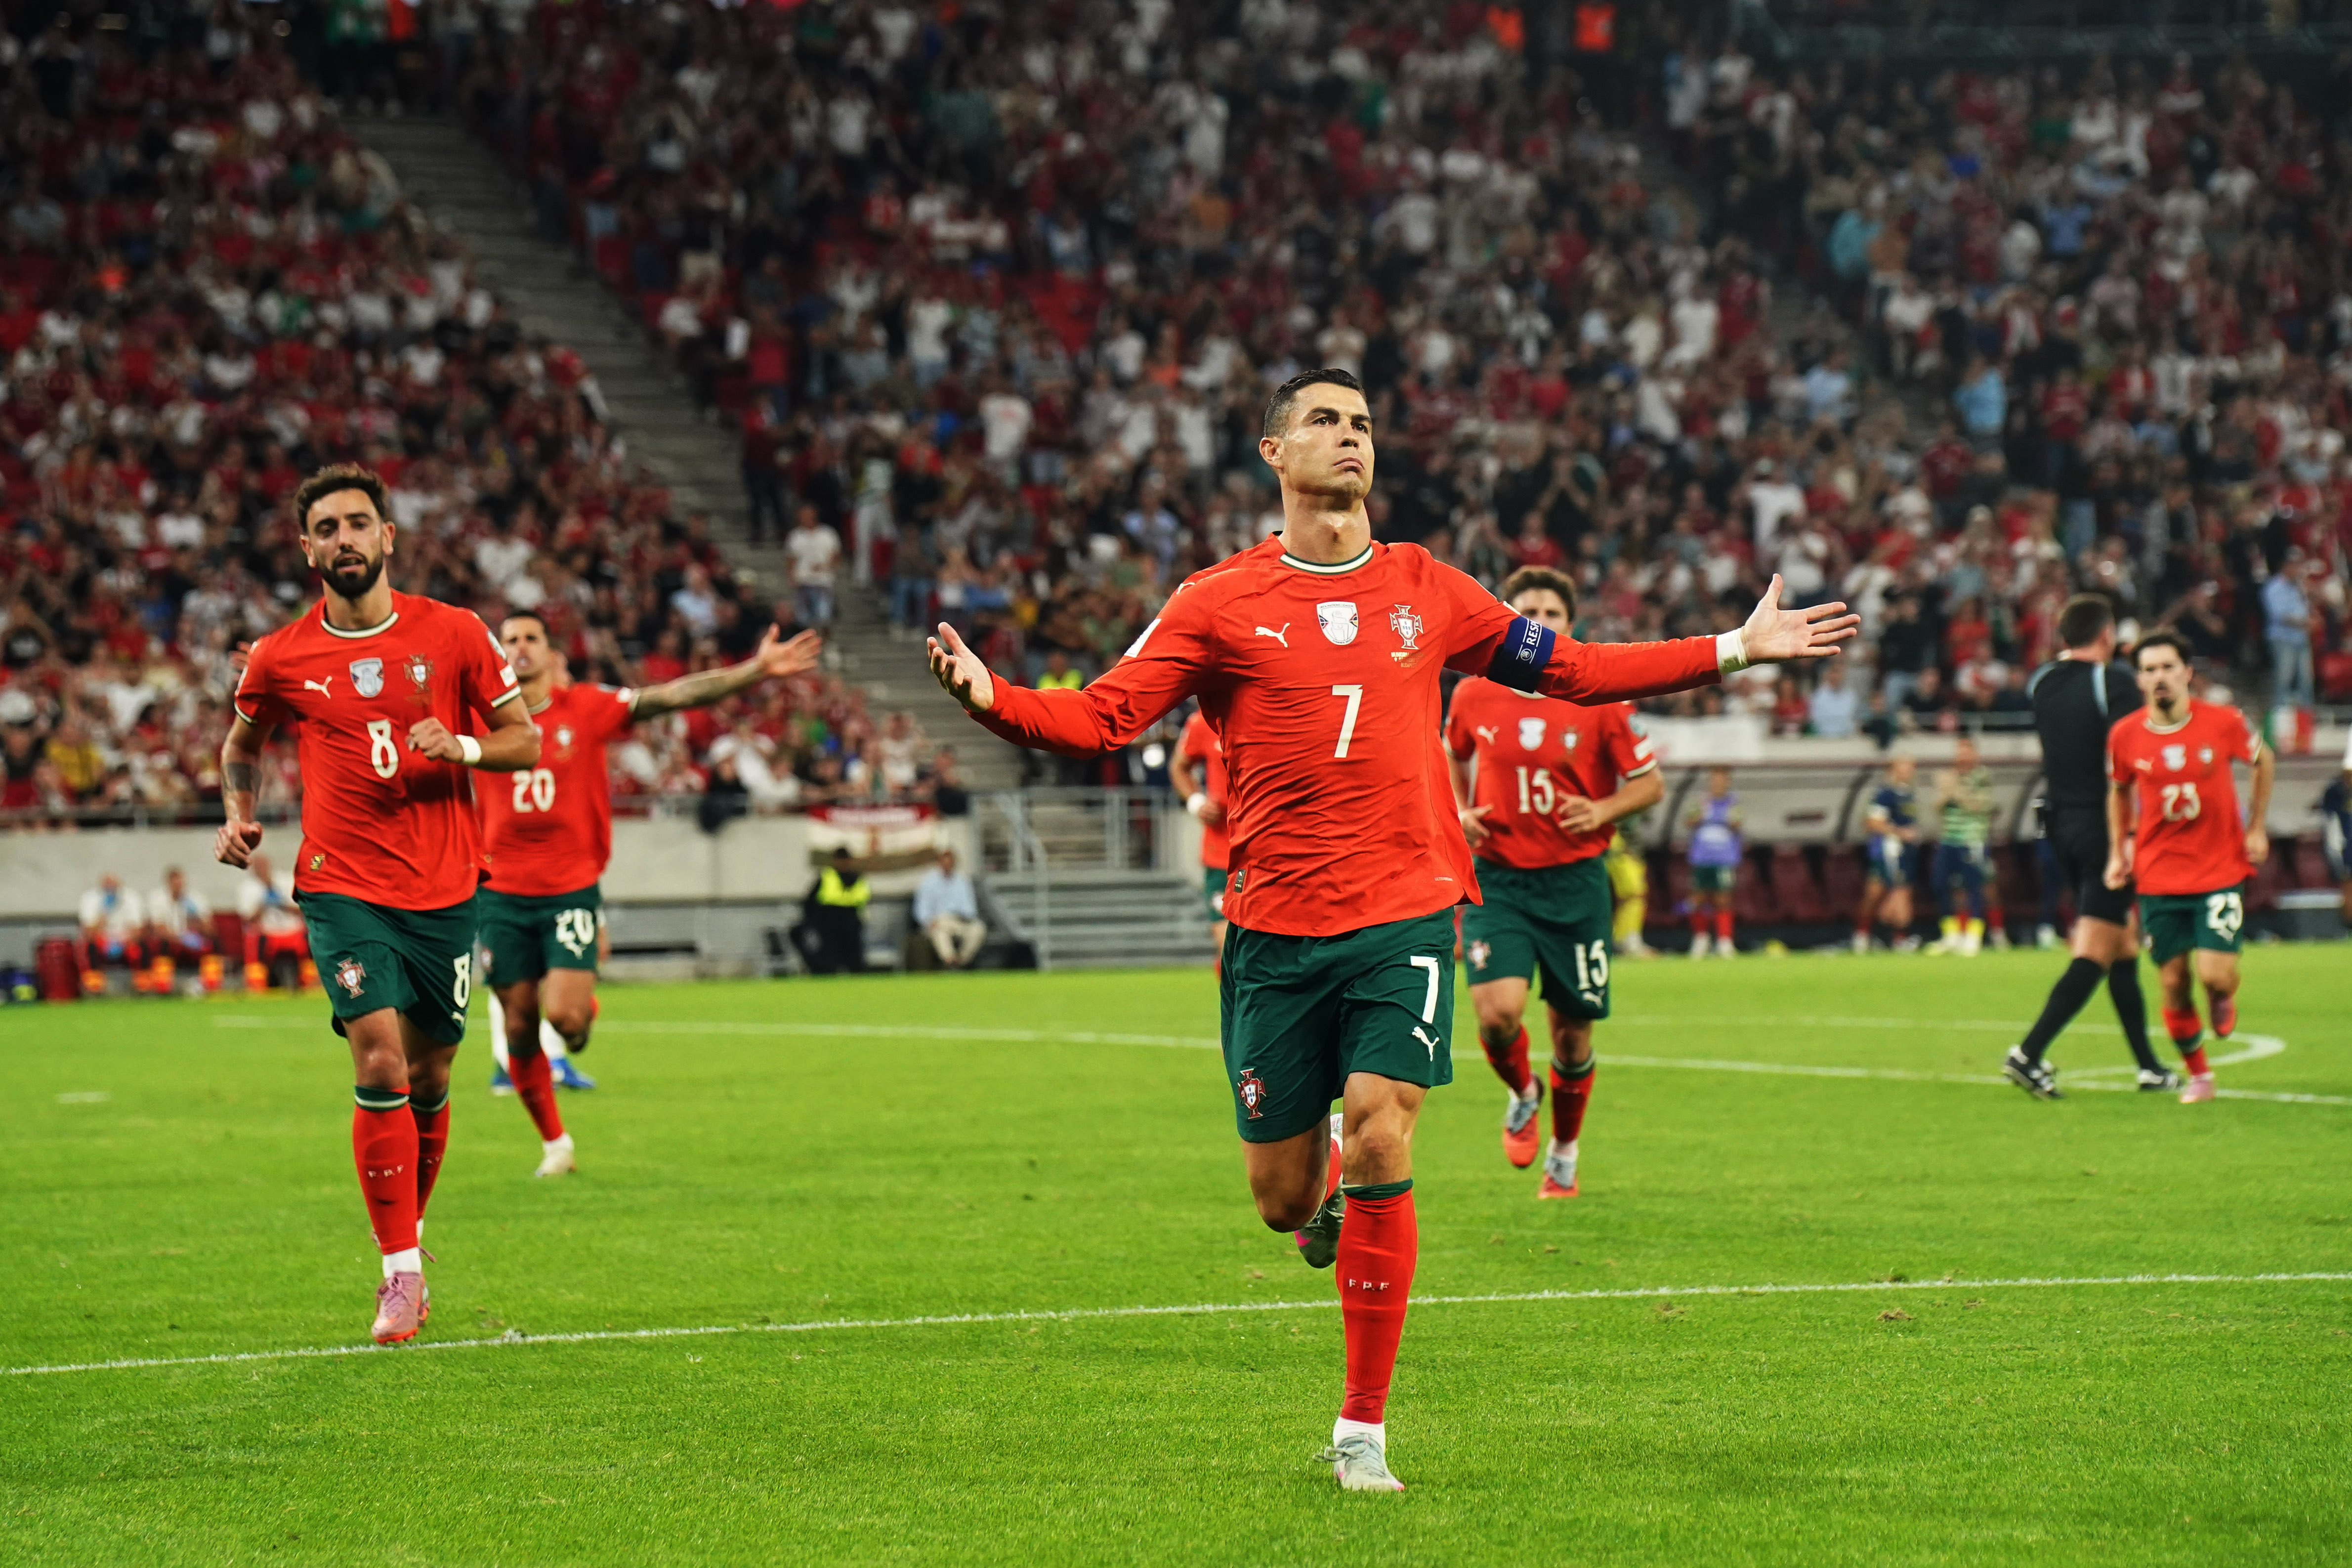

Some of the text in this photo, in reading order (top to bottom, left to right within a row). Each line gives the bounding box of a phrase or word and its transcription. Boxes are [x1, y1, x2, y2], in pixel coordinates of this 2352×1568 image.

[1332, 684, 1363, 758] 7
[367, 720, 398, 778] 8
[512, 768, 555, 812] 20
[1517, 766, 1554, 813] 15
[2161, 782, 2201, 821] 23
[555, 908, 595, 945] 20
[2206, 891, 2243, 931] 23
[454, 952, 470, 1009] 8
[1575, 939, 1609, 989] 15
[1411, 956, 1439, 1023] 7
